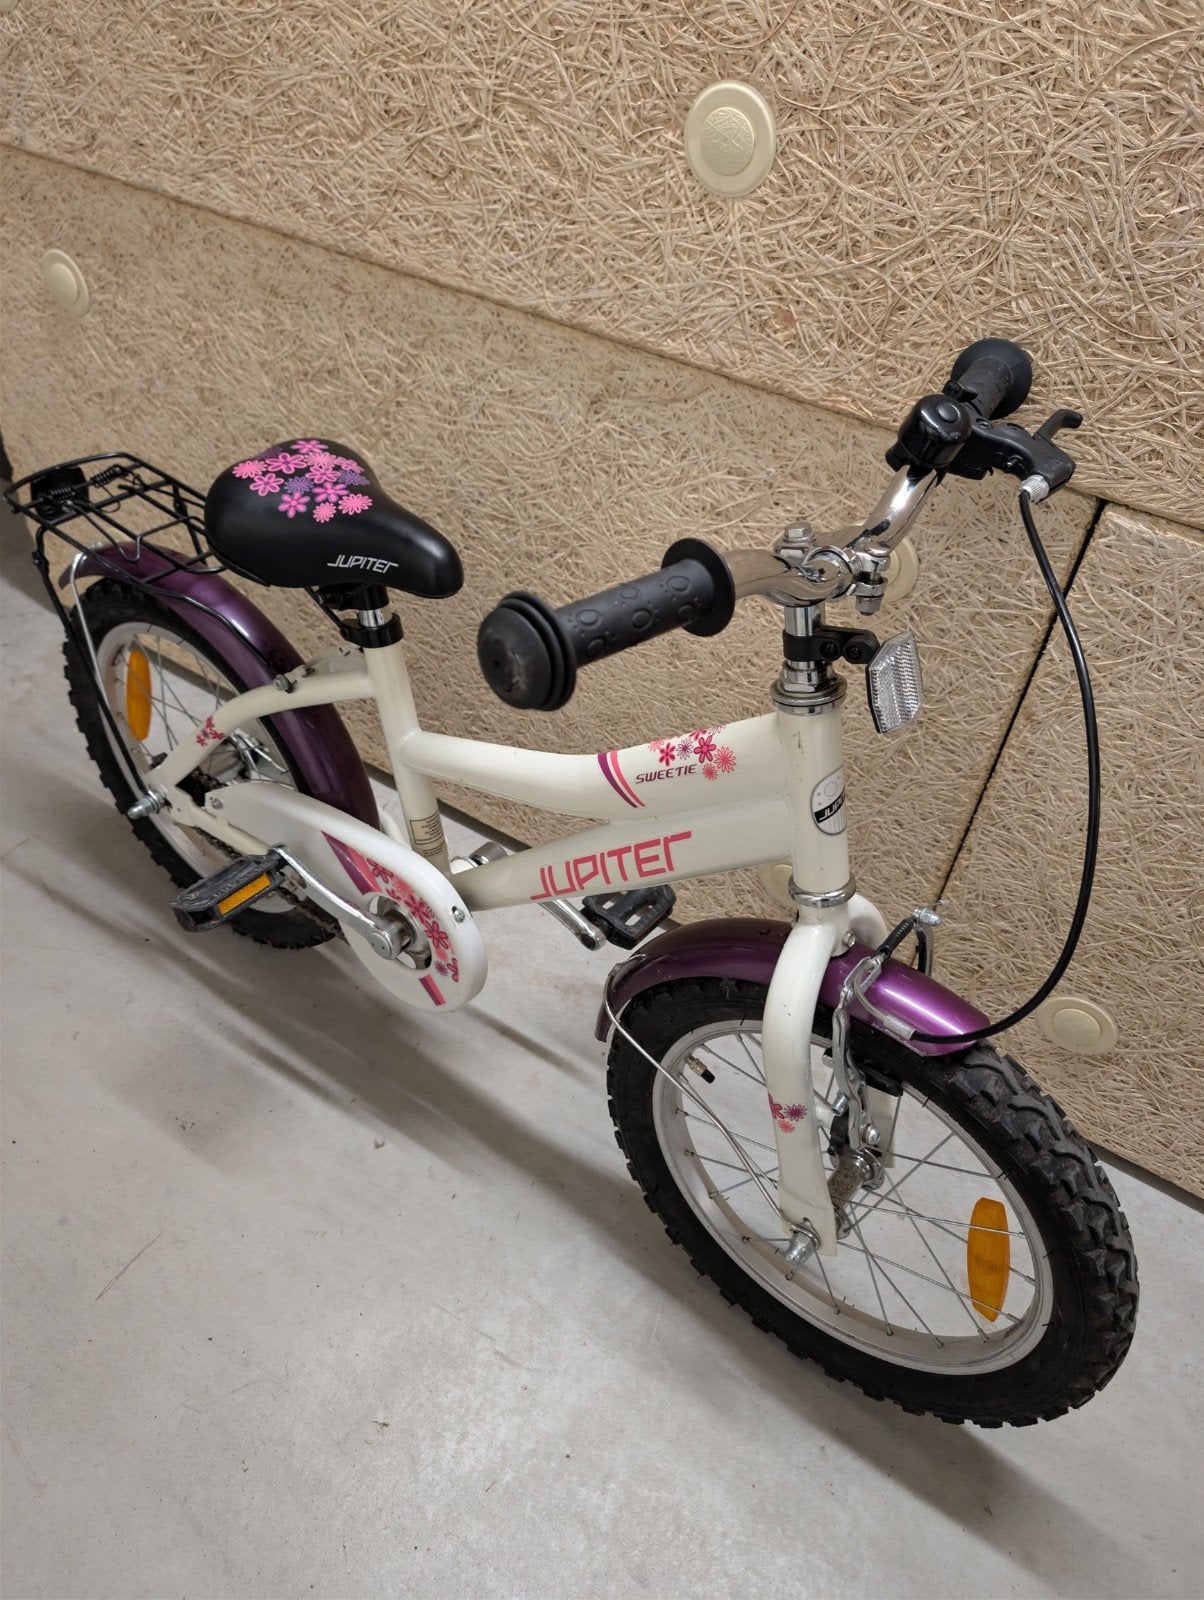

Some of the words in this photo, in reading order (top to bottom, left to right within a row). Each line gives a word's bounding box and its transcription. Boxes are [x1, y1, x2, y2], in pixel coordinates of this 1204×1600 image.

[327, 554, 399, 574] JUPITER
[635, 763, 698, 784] SWEETIE
[530, 830, 692, 901] JUPITER
